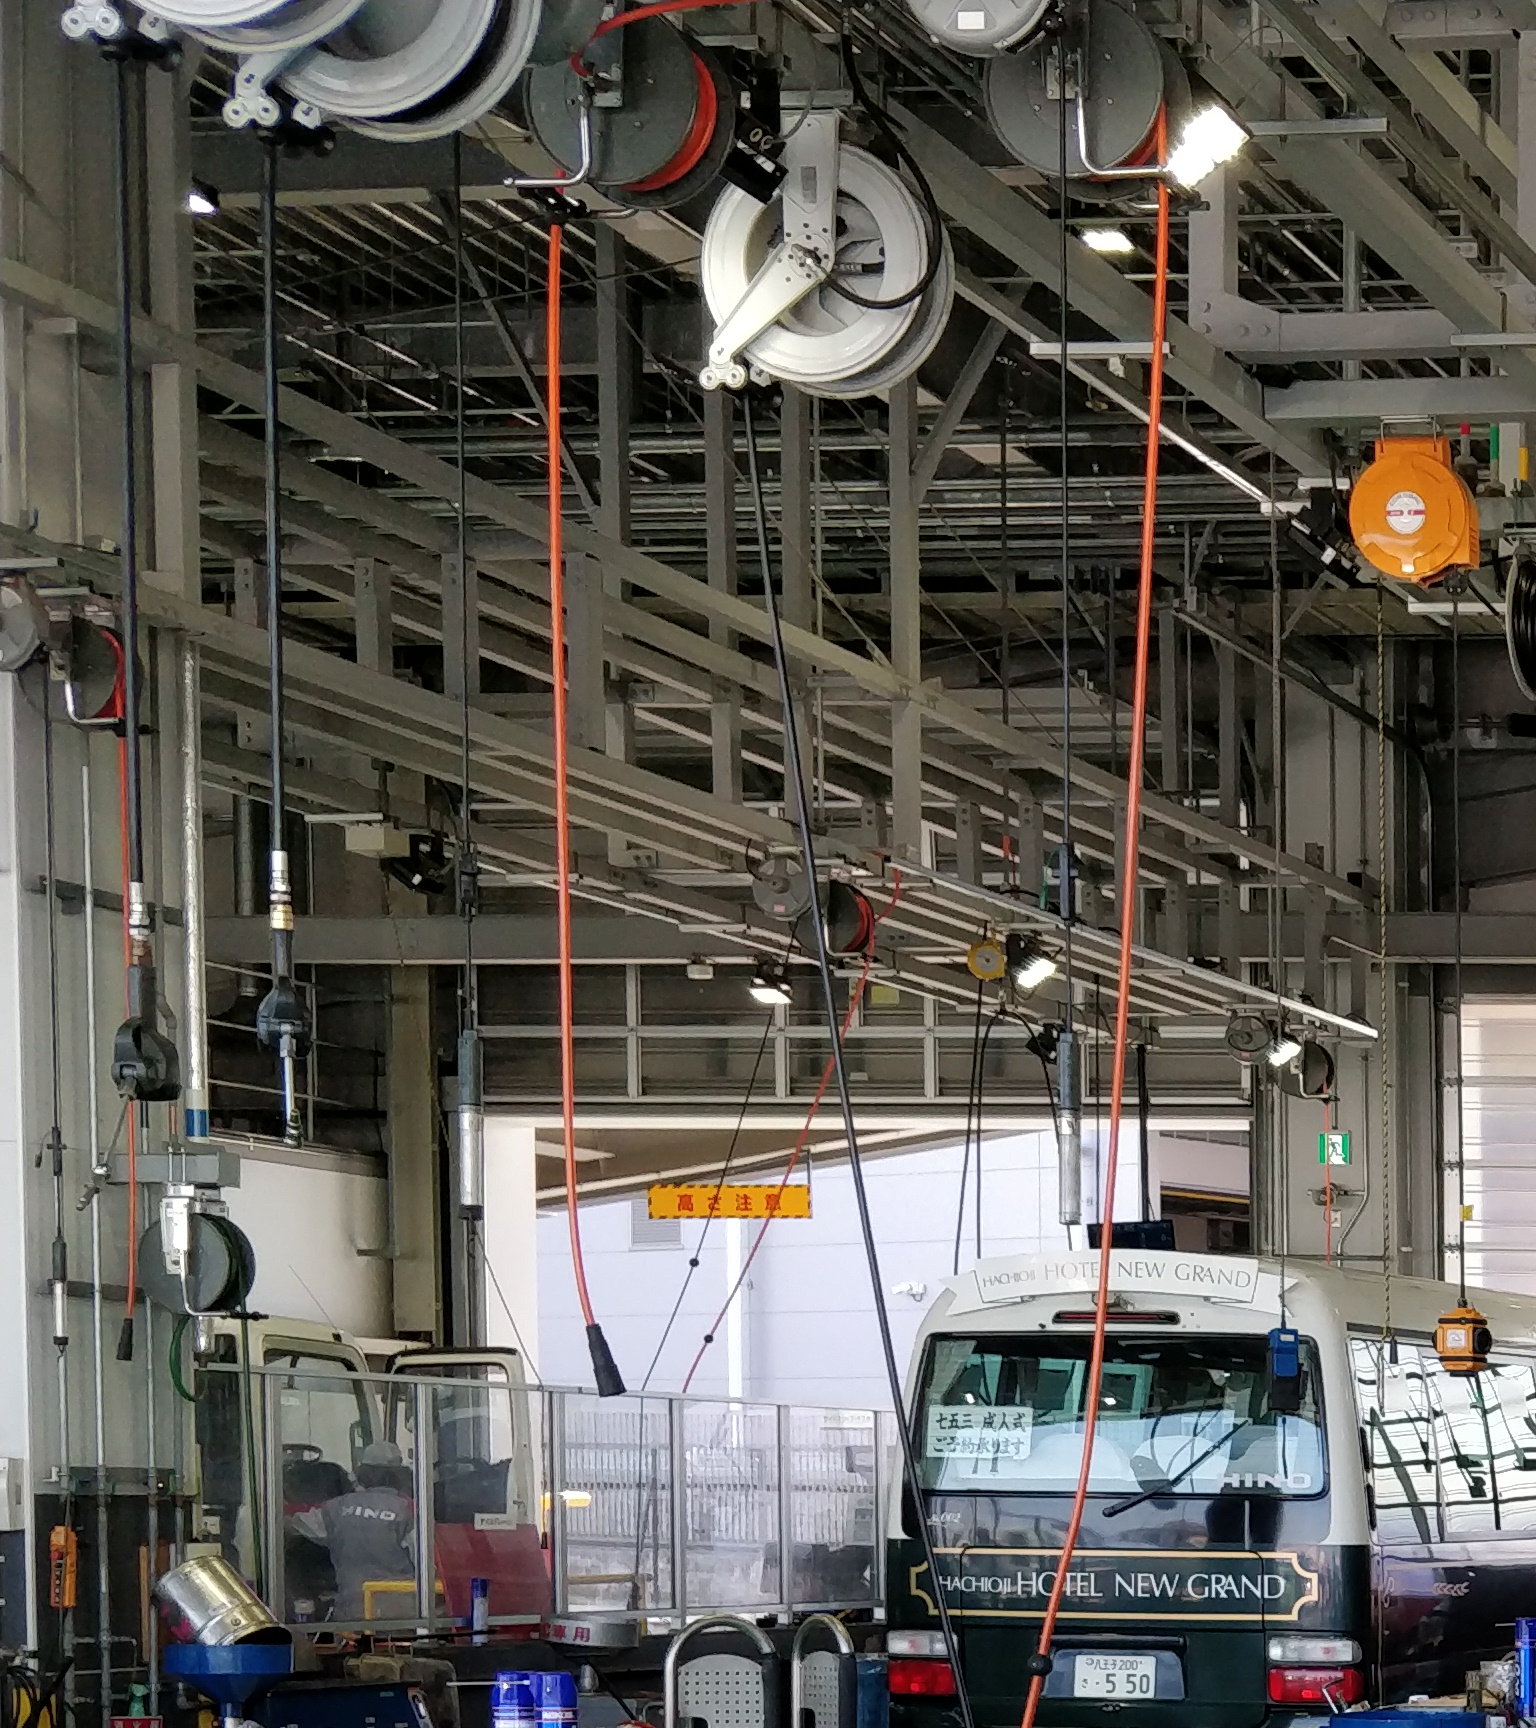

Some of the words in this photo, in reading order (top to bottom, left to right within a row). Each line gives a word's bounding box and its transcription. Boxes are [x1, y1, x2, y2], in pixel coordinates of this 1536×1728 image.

[676, 1193, 782, 1212] 高さ注意
[1044, 1261, 1099, 1281] HOTE
[1117, 1261, 1166, 1279] NEW
[1174, 1263, 1251, 1288] GRAND
[935, 1412, 974, 1430] 七五三
[981, 1411, 1026, 1432] 成人式
[1221, 1472, 1312, 1489] HINO
[341, 1505, 397, 1521] HINO
[939, 1575, 1011, 1595] HACHIOJI
[1016, 1570, 1104, 1598] HOTEL
[1114, 1573, 1181, 1598] NEW
[1187, 1574, 1286, 1599] GRAND
